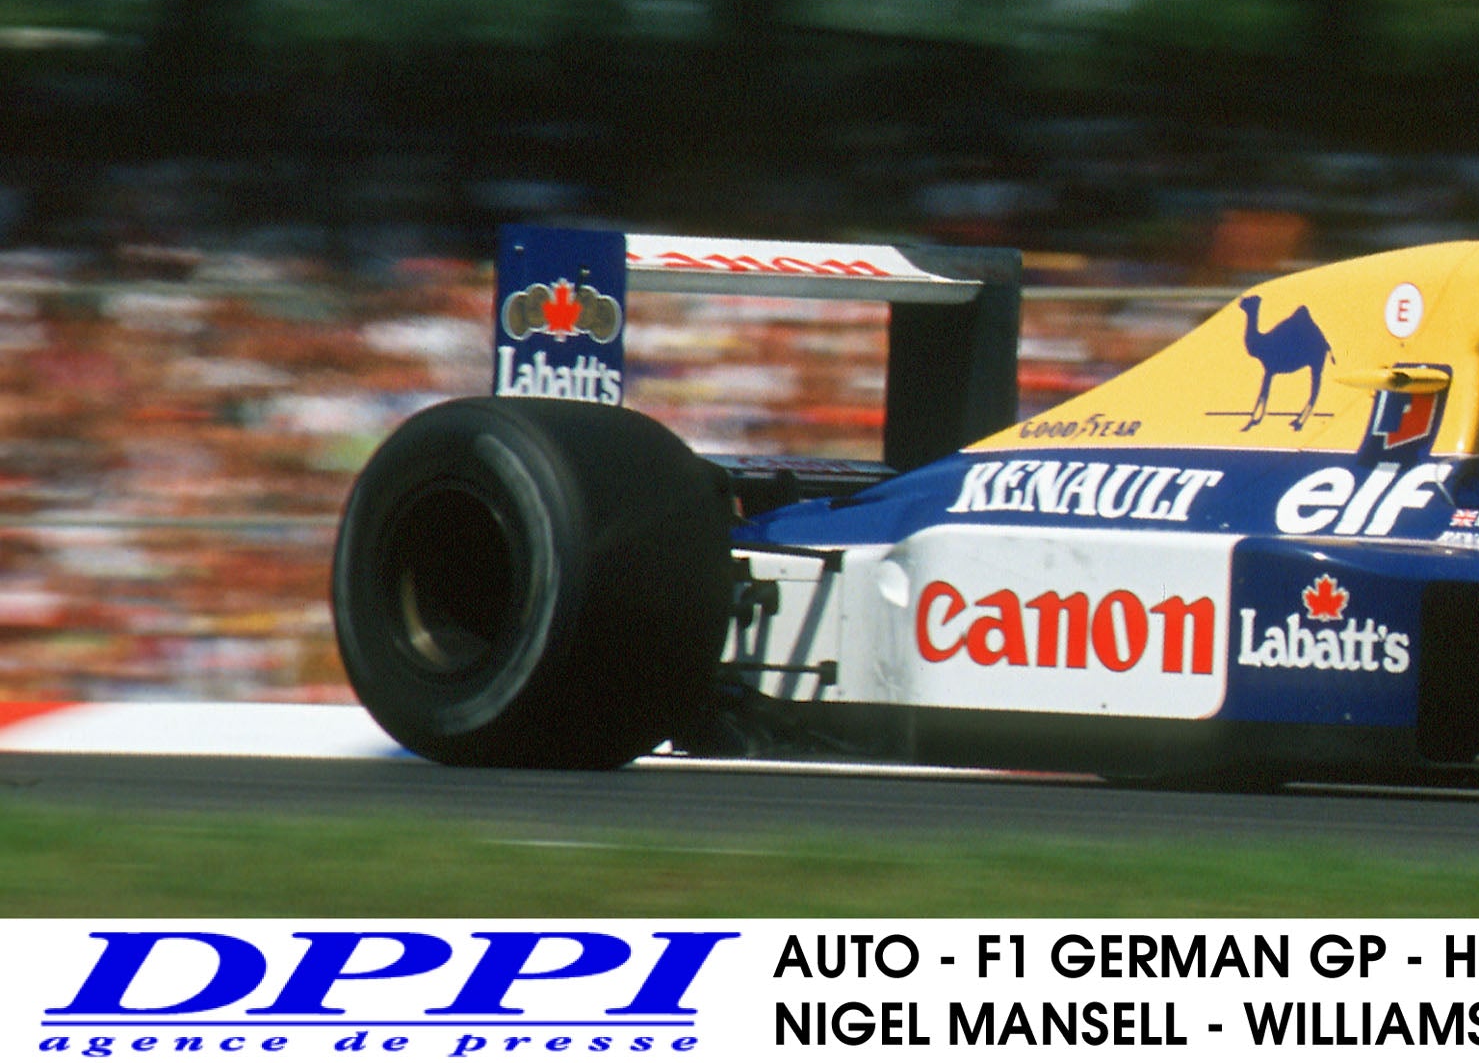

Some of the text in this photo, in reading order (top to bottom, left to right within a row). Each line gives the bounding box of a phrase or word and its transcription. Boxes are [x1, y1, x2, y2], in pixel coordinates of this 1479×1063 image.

[1397, 299, 1410, 324] E
[496, 345, 622, 406] Labatt's
[947, 459, 1225, 522] RENAULT
[1275, 463, 1454, 536] elf
[915, 579, 1215, 675] Canon
[1238, 607, 1410, 673] Labatt's
